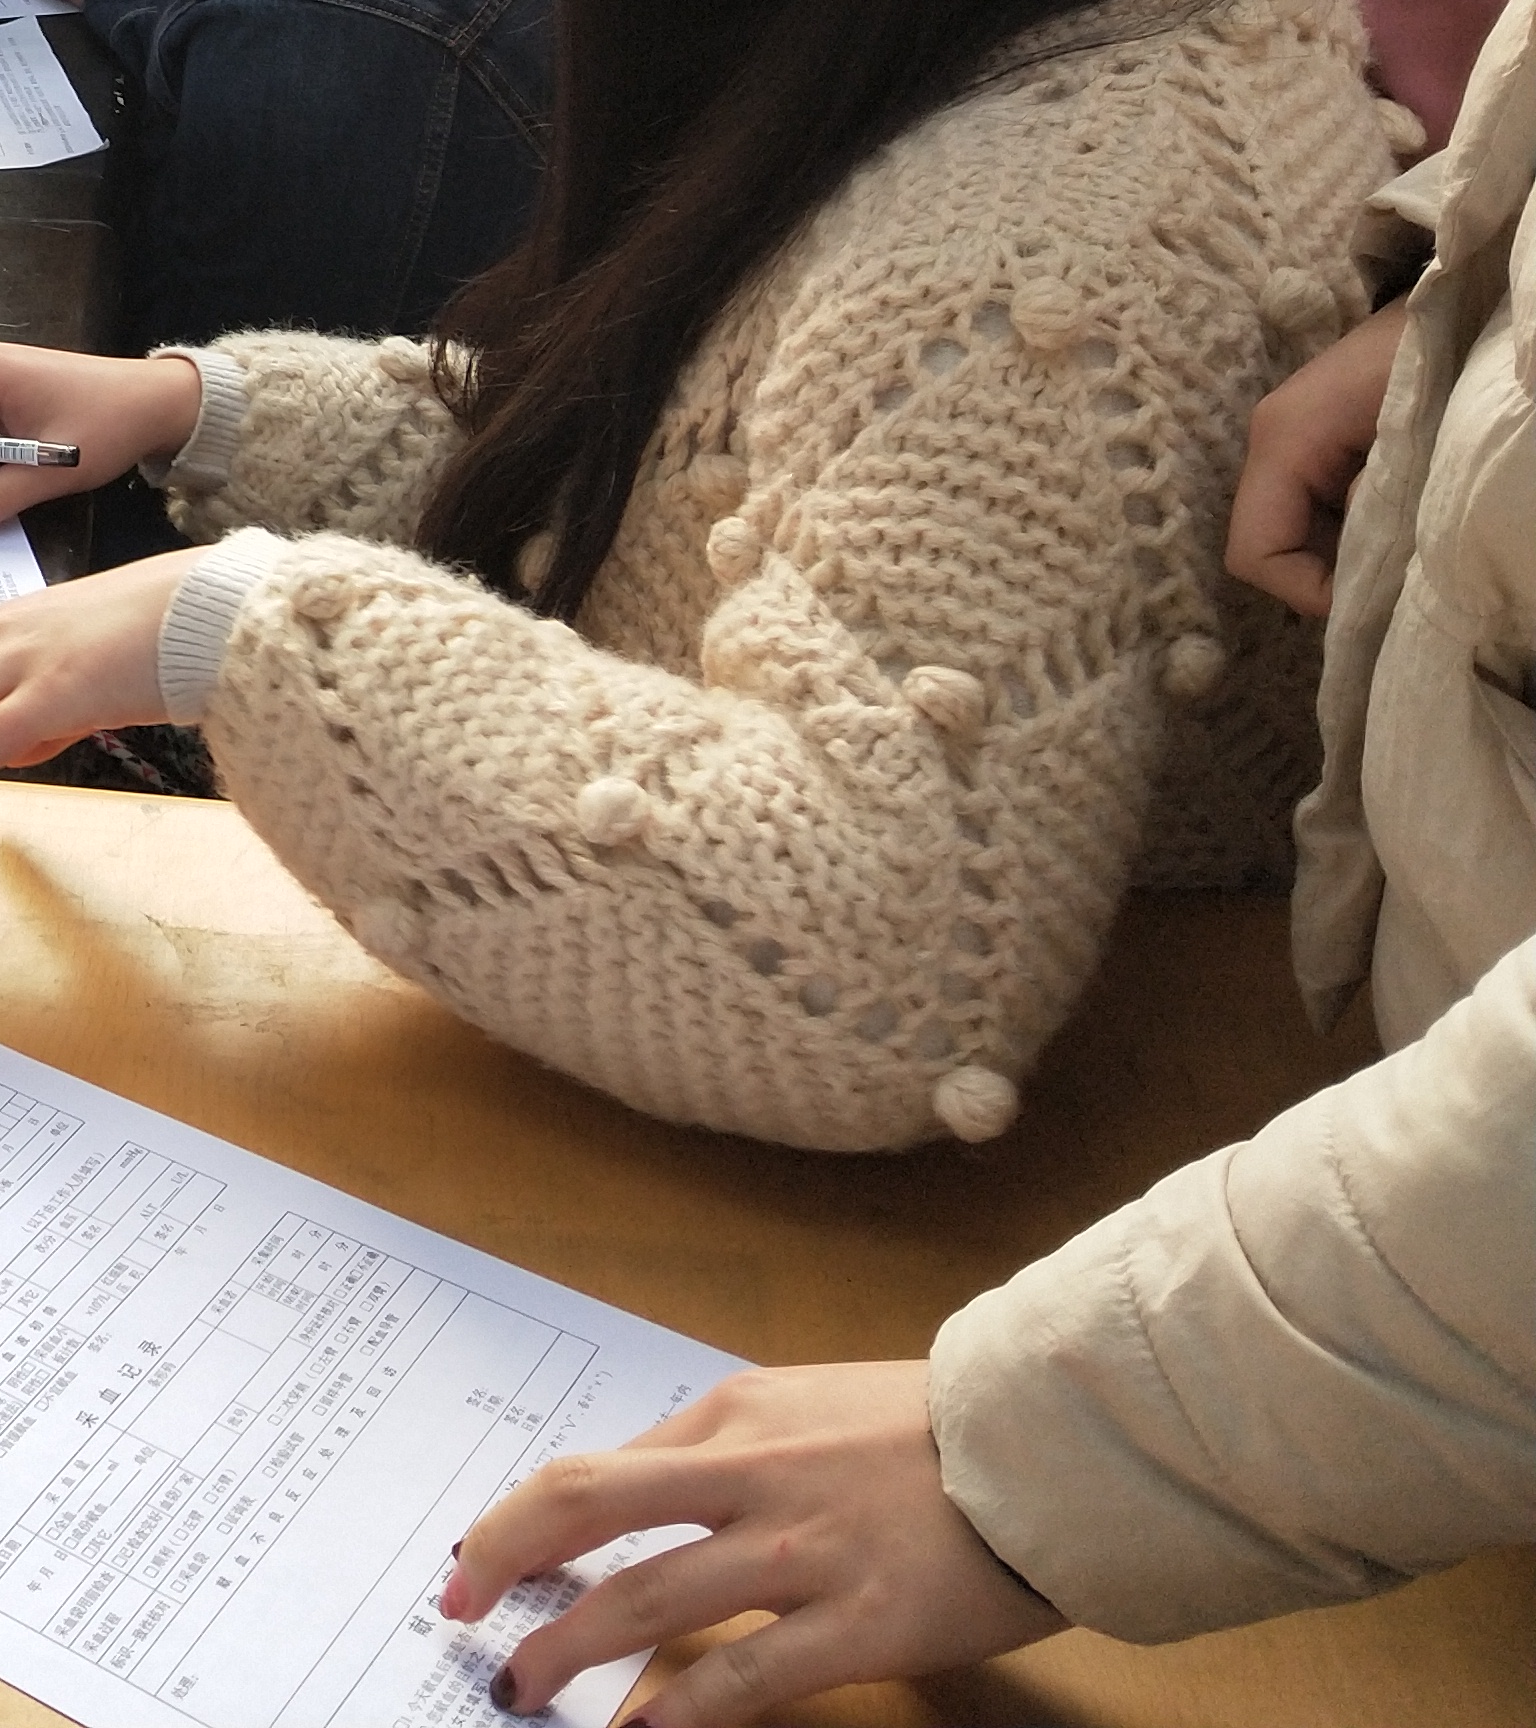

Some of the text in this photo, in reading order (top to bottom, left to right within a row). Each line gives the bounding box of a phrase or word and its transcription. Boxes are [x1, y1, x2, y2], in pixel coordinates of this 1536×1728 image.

[46, 1119, 71, 1138] 单位
[0, 1142, 16, 1153] 月
[79, 1222, 103, 1241] 签名
[150, 1221, 176, 1241] 签名
[172, 1244, 191, 1257] 年
[191, 1223, 209, 1235] 月
[212, 1203, 227, 1213] 日
[305, 1227, 324, 1240] 分
[331, 1238, 351, 1252] 分
[15, 1287, 41, 1308] 其它
[208, 1288, 239, 1316] 采血者
[71, 1336, 164, 1430] 采血记录
[144, 1359, 178, 1389] 条形码
[130, 1443, 158, 1467] 单位
[43, 1457, 91, 1505] 采血量
[155, 1471, 197, 1512] 血袋厂家
[213, 1363, 398, 1591] 献血不良反应处理及回访
[50, 1507, 78, 1532] 全血
[86, 1527, 115, 1552] 其它
[24, 1548, 70, 1594] 年 月 日
[177, 1549, 212, 1584] 采血袋
[51, 1568, 117, 1640] 采血袋用前检查
[80, 1610, 124, 1655] 采血过程
[108, 1598, 172, 1671] 标识一致性核对
